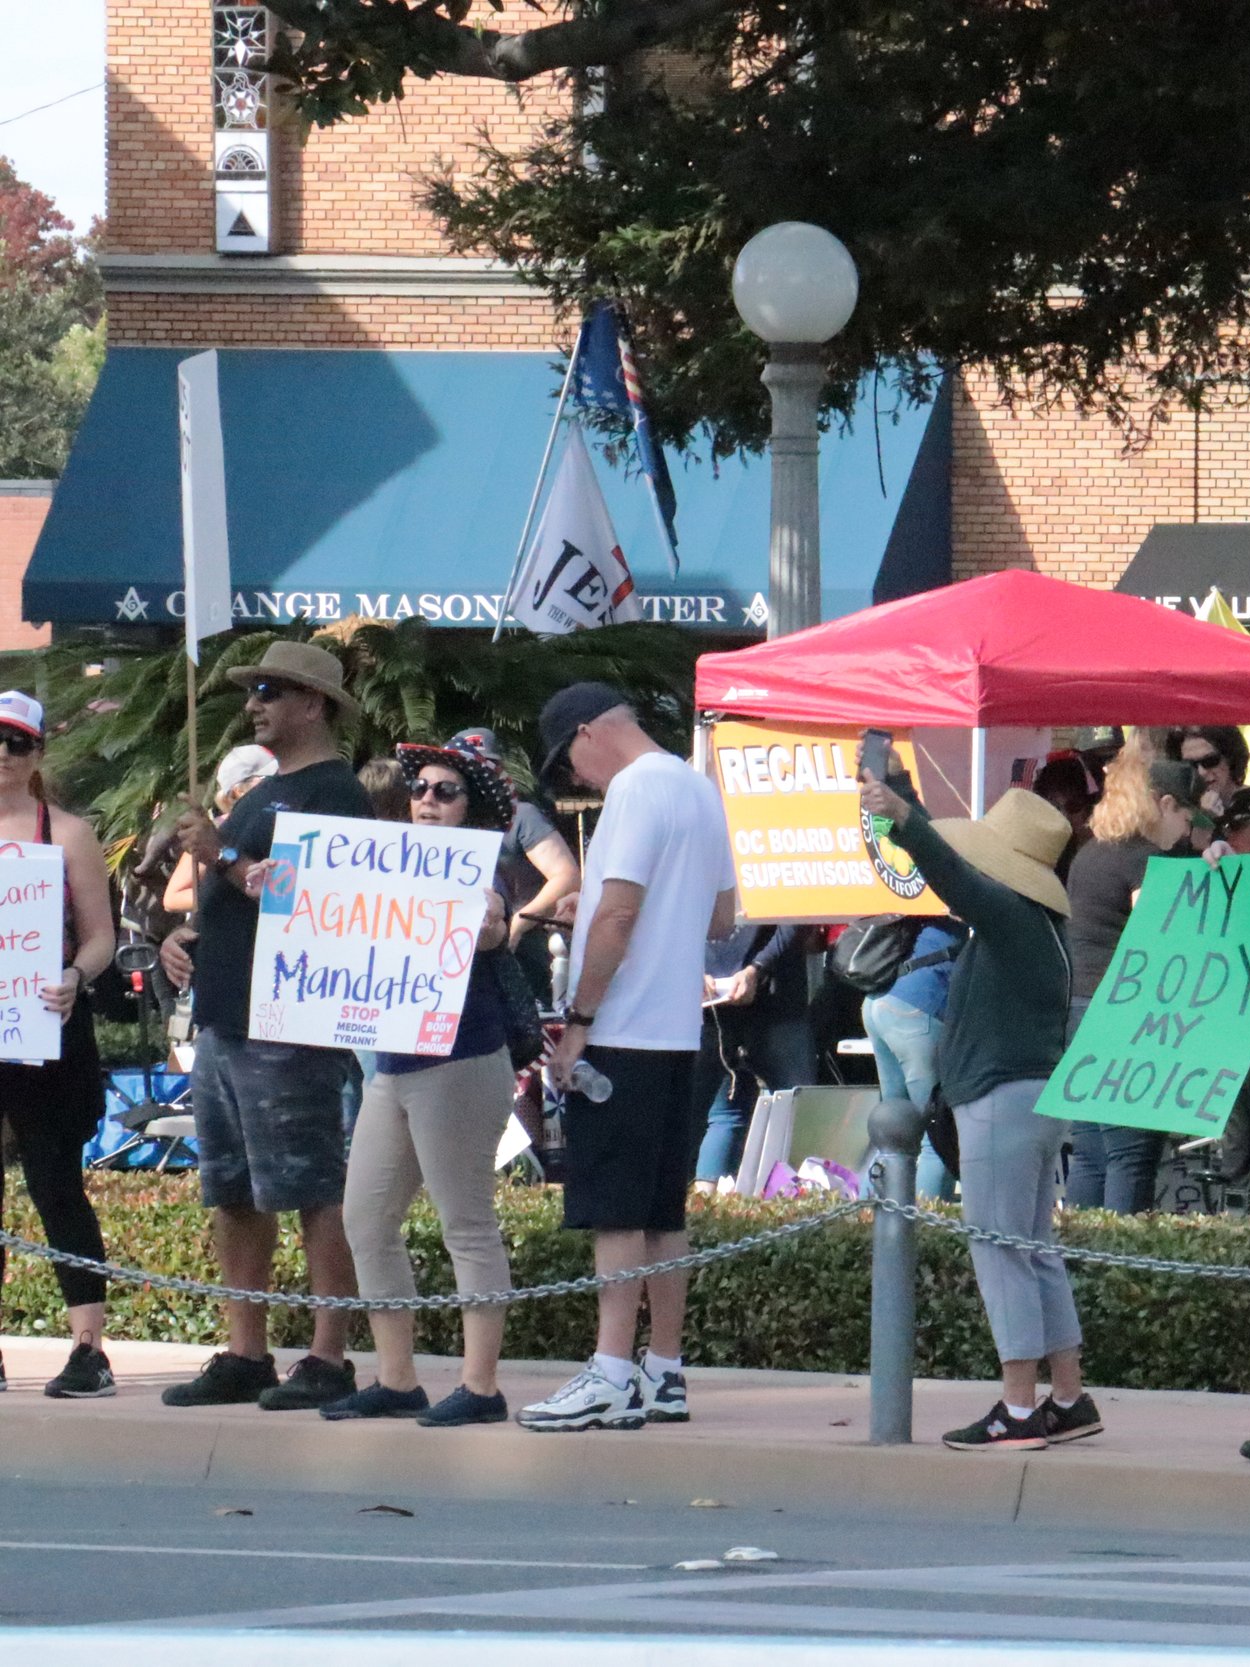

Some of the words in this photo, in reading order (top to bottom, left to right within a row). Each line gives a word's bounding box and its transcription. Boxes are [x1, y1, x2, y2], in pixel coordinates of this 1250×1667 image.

[166, 592, 341, 619] OANGE
[355, 593, 515, 622] MASON
[639, 596, 727, 622] TER
[718, 743, 858, 794] RECALL
[735, 829, 765, 855] OC
[768, 828, 833, 854] BOARD
[837, 827, 861, 851] OF
[299, 829, 482, 887] Teachers
[741, 860, 874, 888] SUPERVISORS
[875, 859, 926, 896] CALIFORN
[0, 880, 52, 906] ant
[1160, 862, 1243, 937] MY
[283, 888, 464, 946] AGAINST
[272, 945, 444, 1012] Mandates
[256, 1002, 286, 1025] SAY
[341, 1005, 381, 1022] STOP
[435, 1013, 446, 1023] MY
[259, 1023, 284, 1039] NO!
[333, 1034, 378, 1047] TYRANNY
[336, 1021, 378, 1035] MEDICAL
[425, 1022, 453, 1034] BODY
[430, 1034, 442, 1043] MY
[1130, 1011, 1205, 1049] MY
[416, 1042, 451, 1054] CHOICE
[1063, 1054, 1240, 1123] CHOICE
